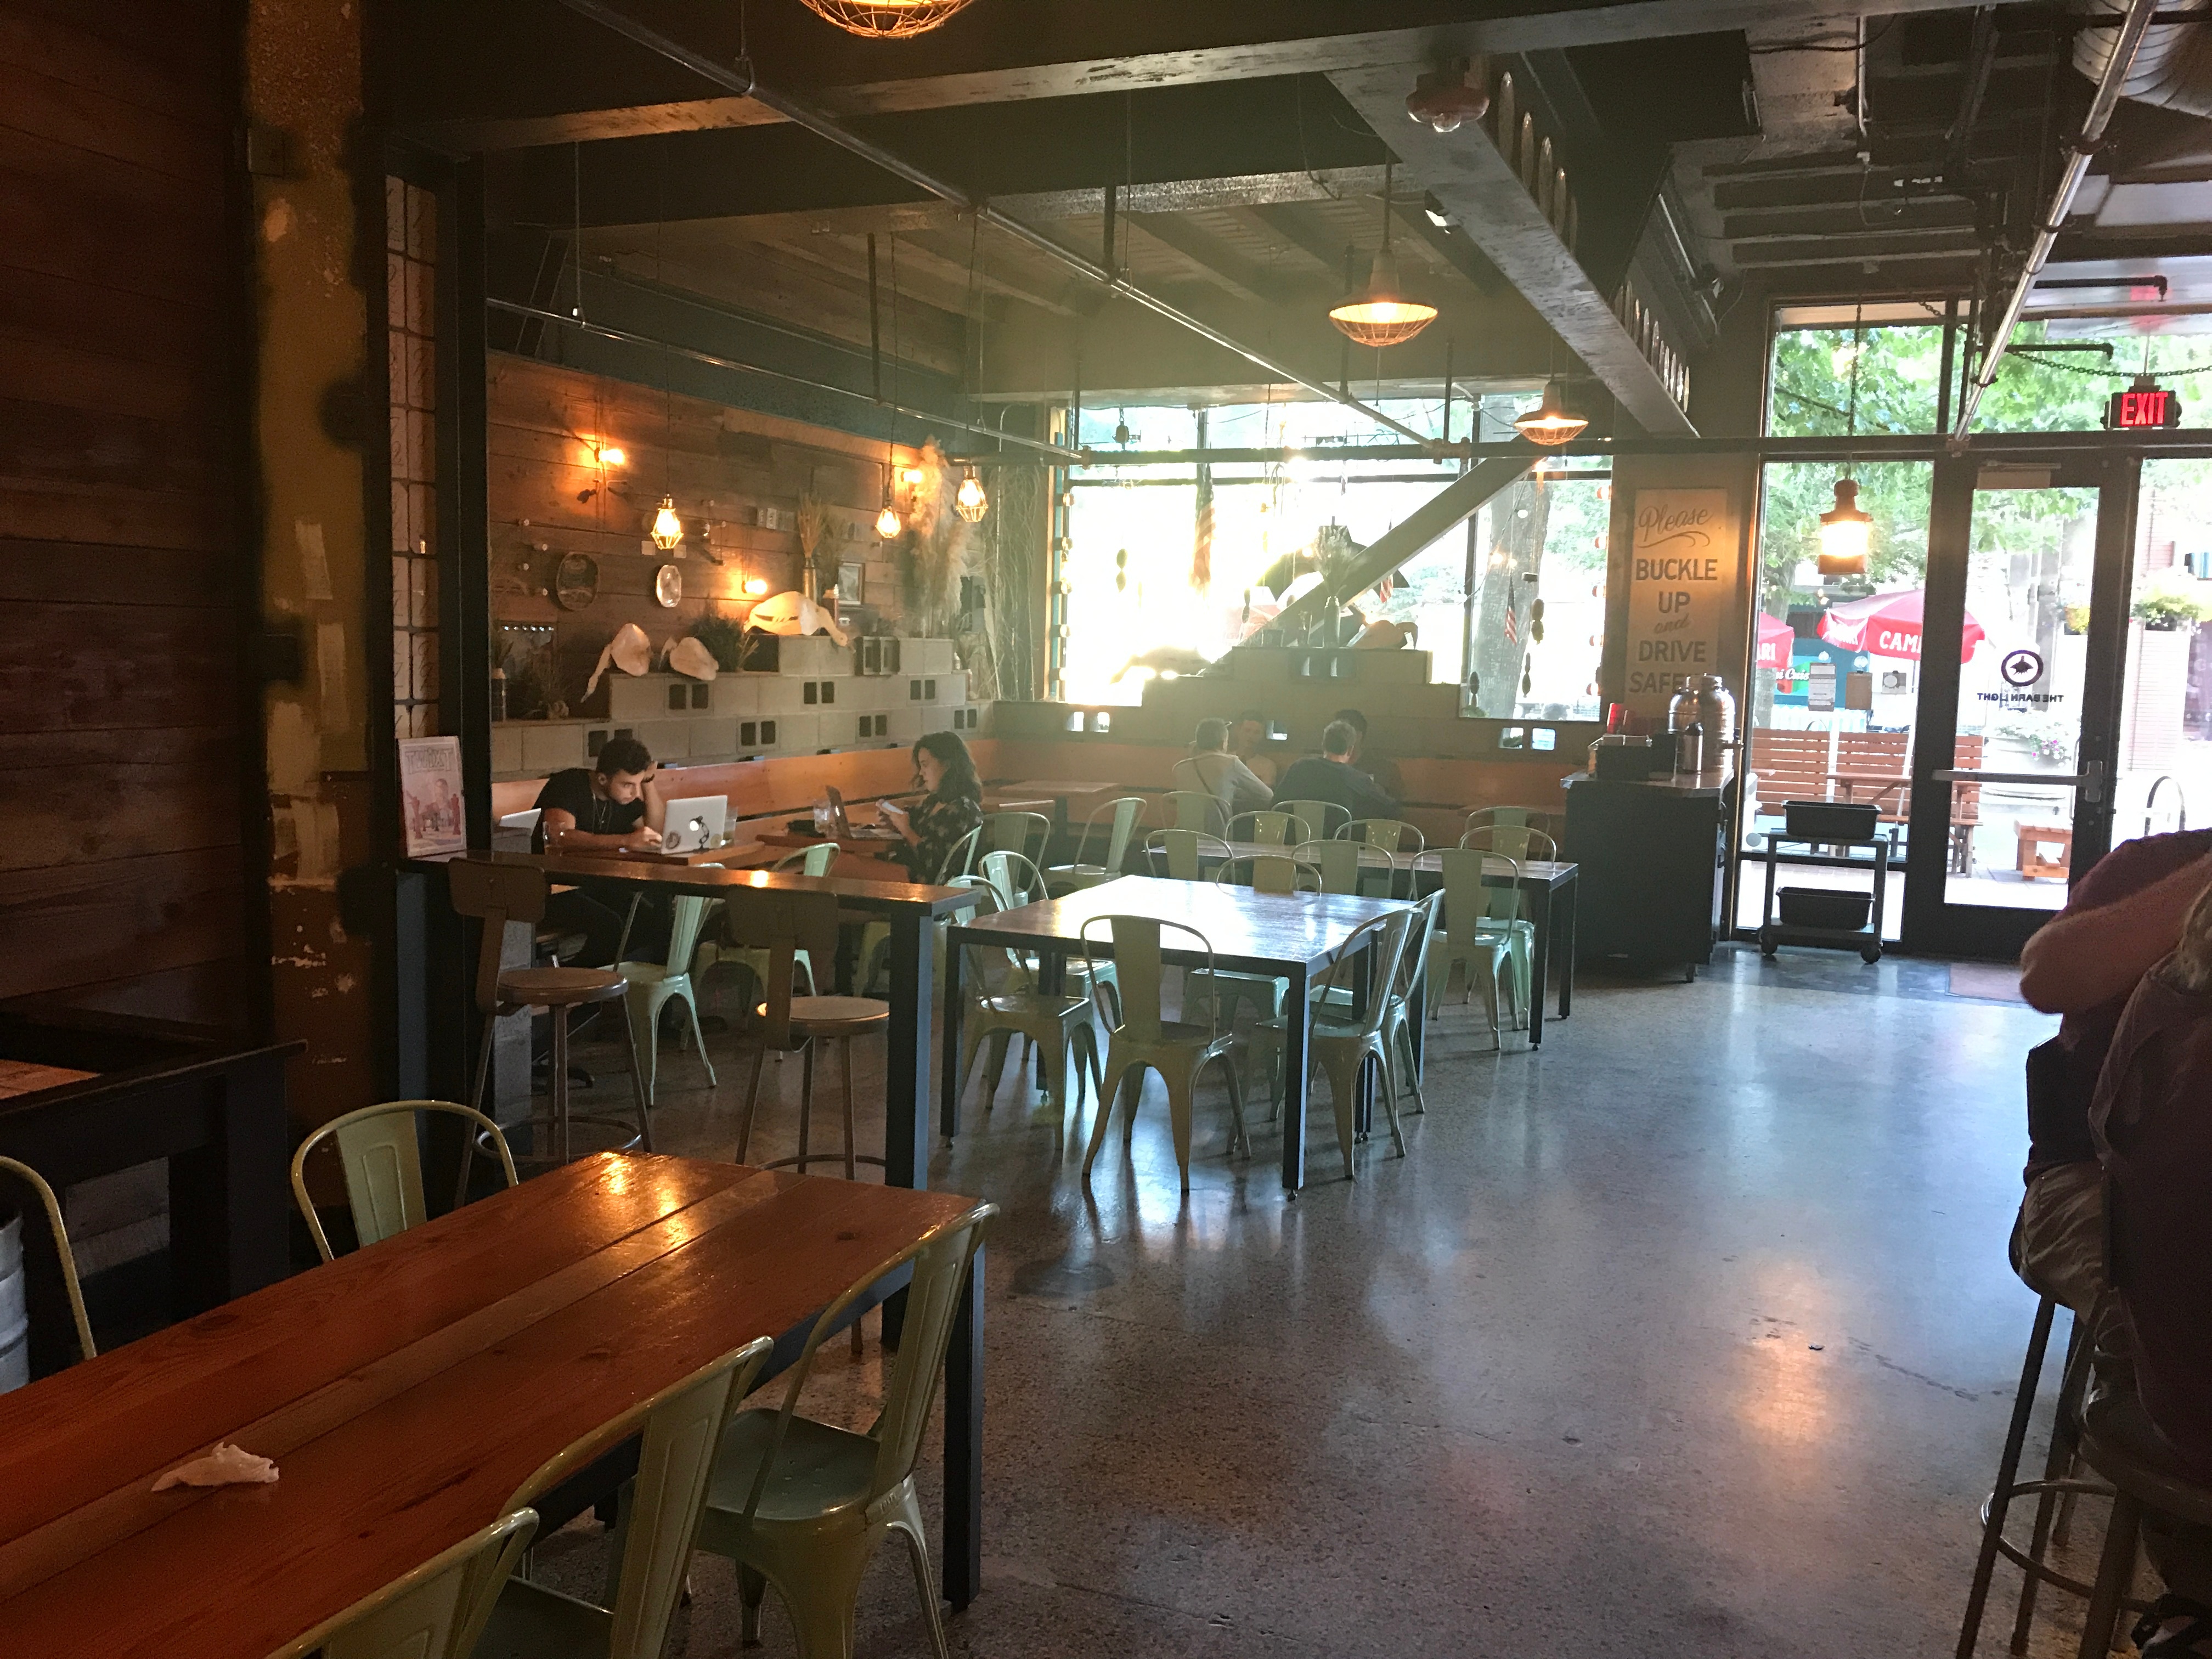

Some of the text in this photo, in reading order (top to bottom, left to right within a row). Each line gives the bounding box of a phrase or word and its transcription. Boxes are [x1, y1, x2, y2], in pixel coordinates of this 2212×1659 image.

[2120, 391, 2168, 426] EXIT
[1637, 504, 1714, 541] Please
[1636, 558, 1718, 580] BUCKLE
[1658, 591, 1690, 613] UP
[1654, 613, 1691, 634] and
[1639, 640, 1706, 662] DRIVE
